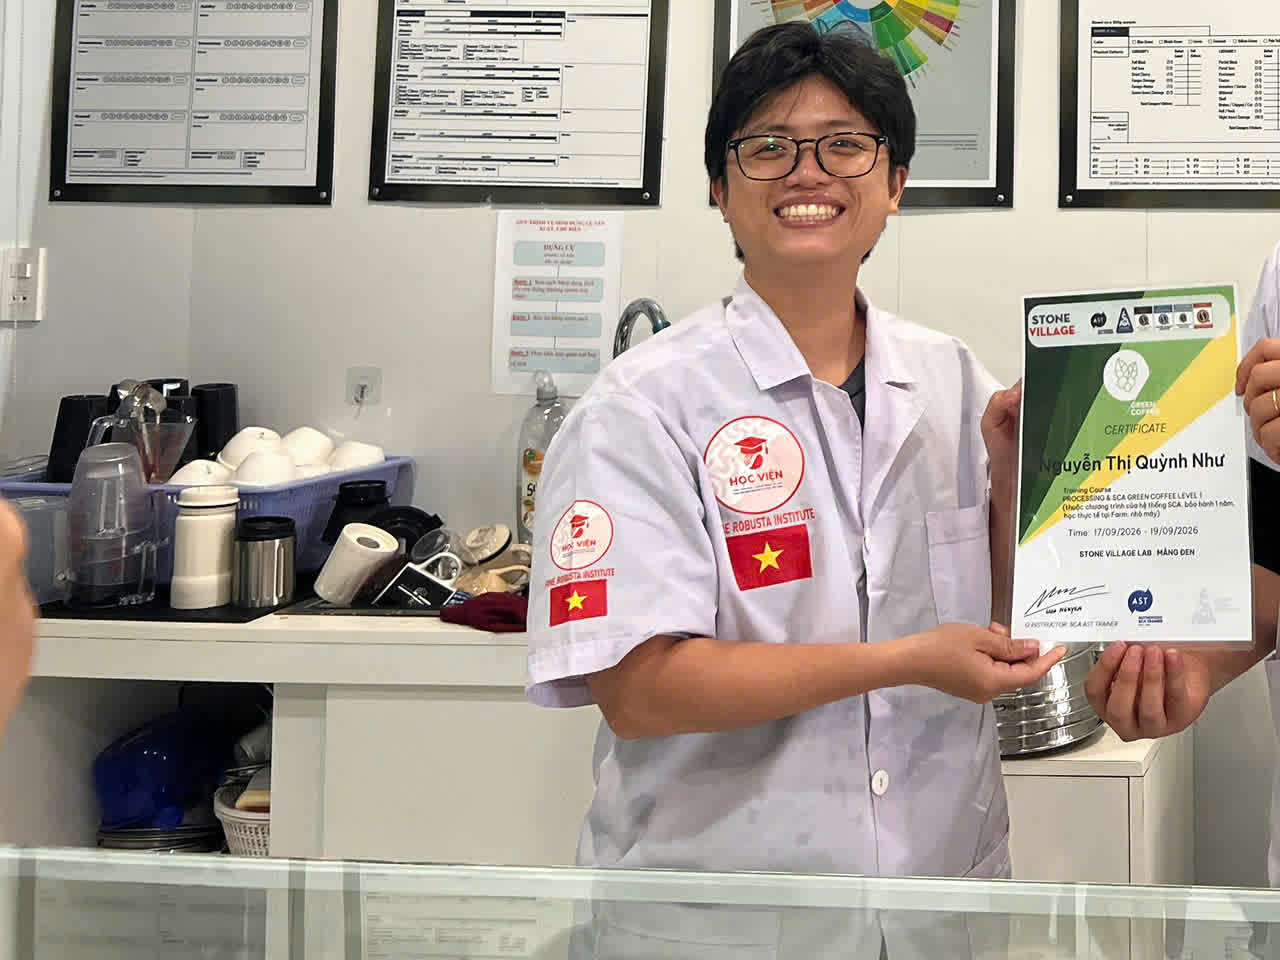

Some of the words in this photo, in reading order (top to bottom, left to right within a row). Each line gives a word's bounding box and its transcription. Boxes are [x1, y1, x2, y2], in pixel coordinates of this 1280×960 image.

[1031, 313, 1071, 325] STONE
[1029, 325, 1076, 337] VILLAGE
[1104, 423, 1167, 435] CERTIFICATE
[1041, 453, 1102, 475] Nguyễn
[1105, 455, 1131, 474] Thị
[1135, 453, 1188, 473] Quỳnh
[1192, 452, 1226, 468] Như
[729, 474, 755, 487] HỌC
[757, 470, 784, 482] VIỆN
[1089, 486, 1112, 494] Course
[1062, 494, 1105, 502] PROCESSING
[1127, 493, 1149, 501] GREEN
[1150, 492, 1177, 500] COFFEE
[1177, 491, 1197, 500] LEVEL
[732, 516, 772, 533] ROBUSTA
[773, 507, 816, 525] INSTITUTE
[1094, 527, 1142, 537] 17/09/2026
[1150, 526, 1199, 536] 19/09/2026
[1079, 550, 1104, 558] STONE
[1105, 549, 1136, 557] VILLAGE
[1137, 549, 1152, 557] LAB
[1132, 597, 1148, 605] AST
